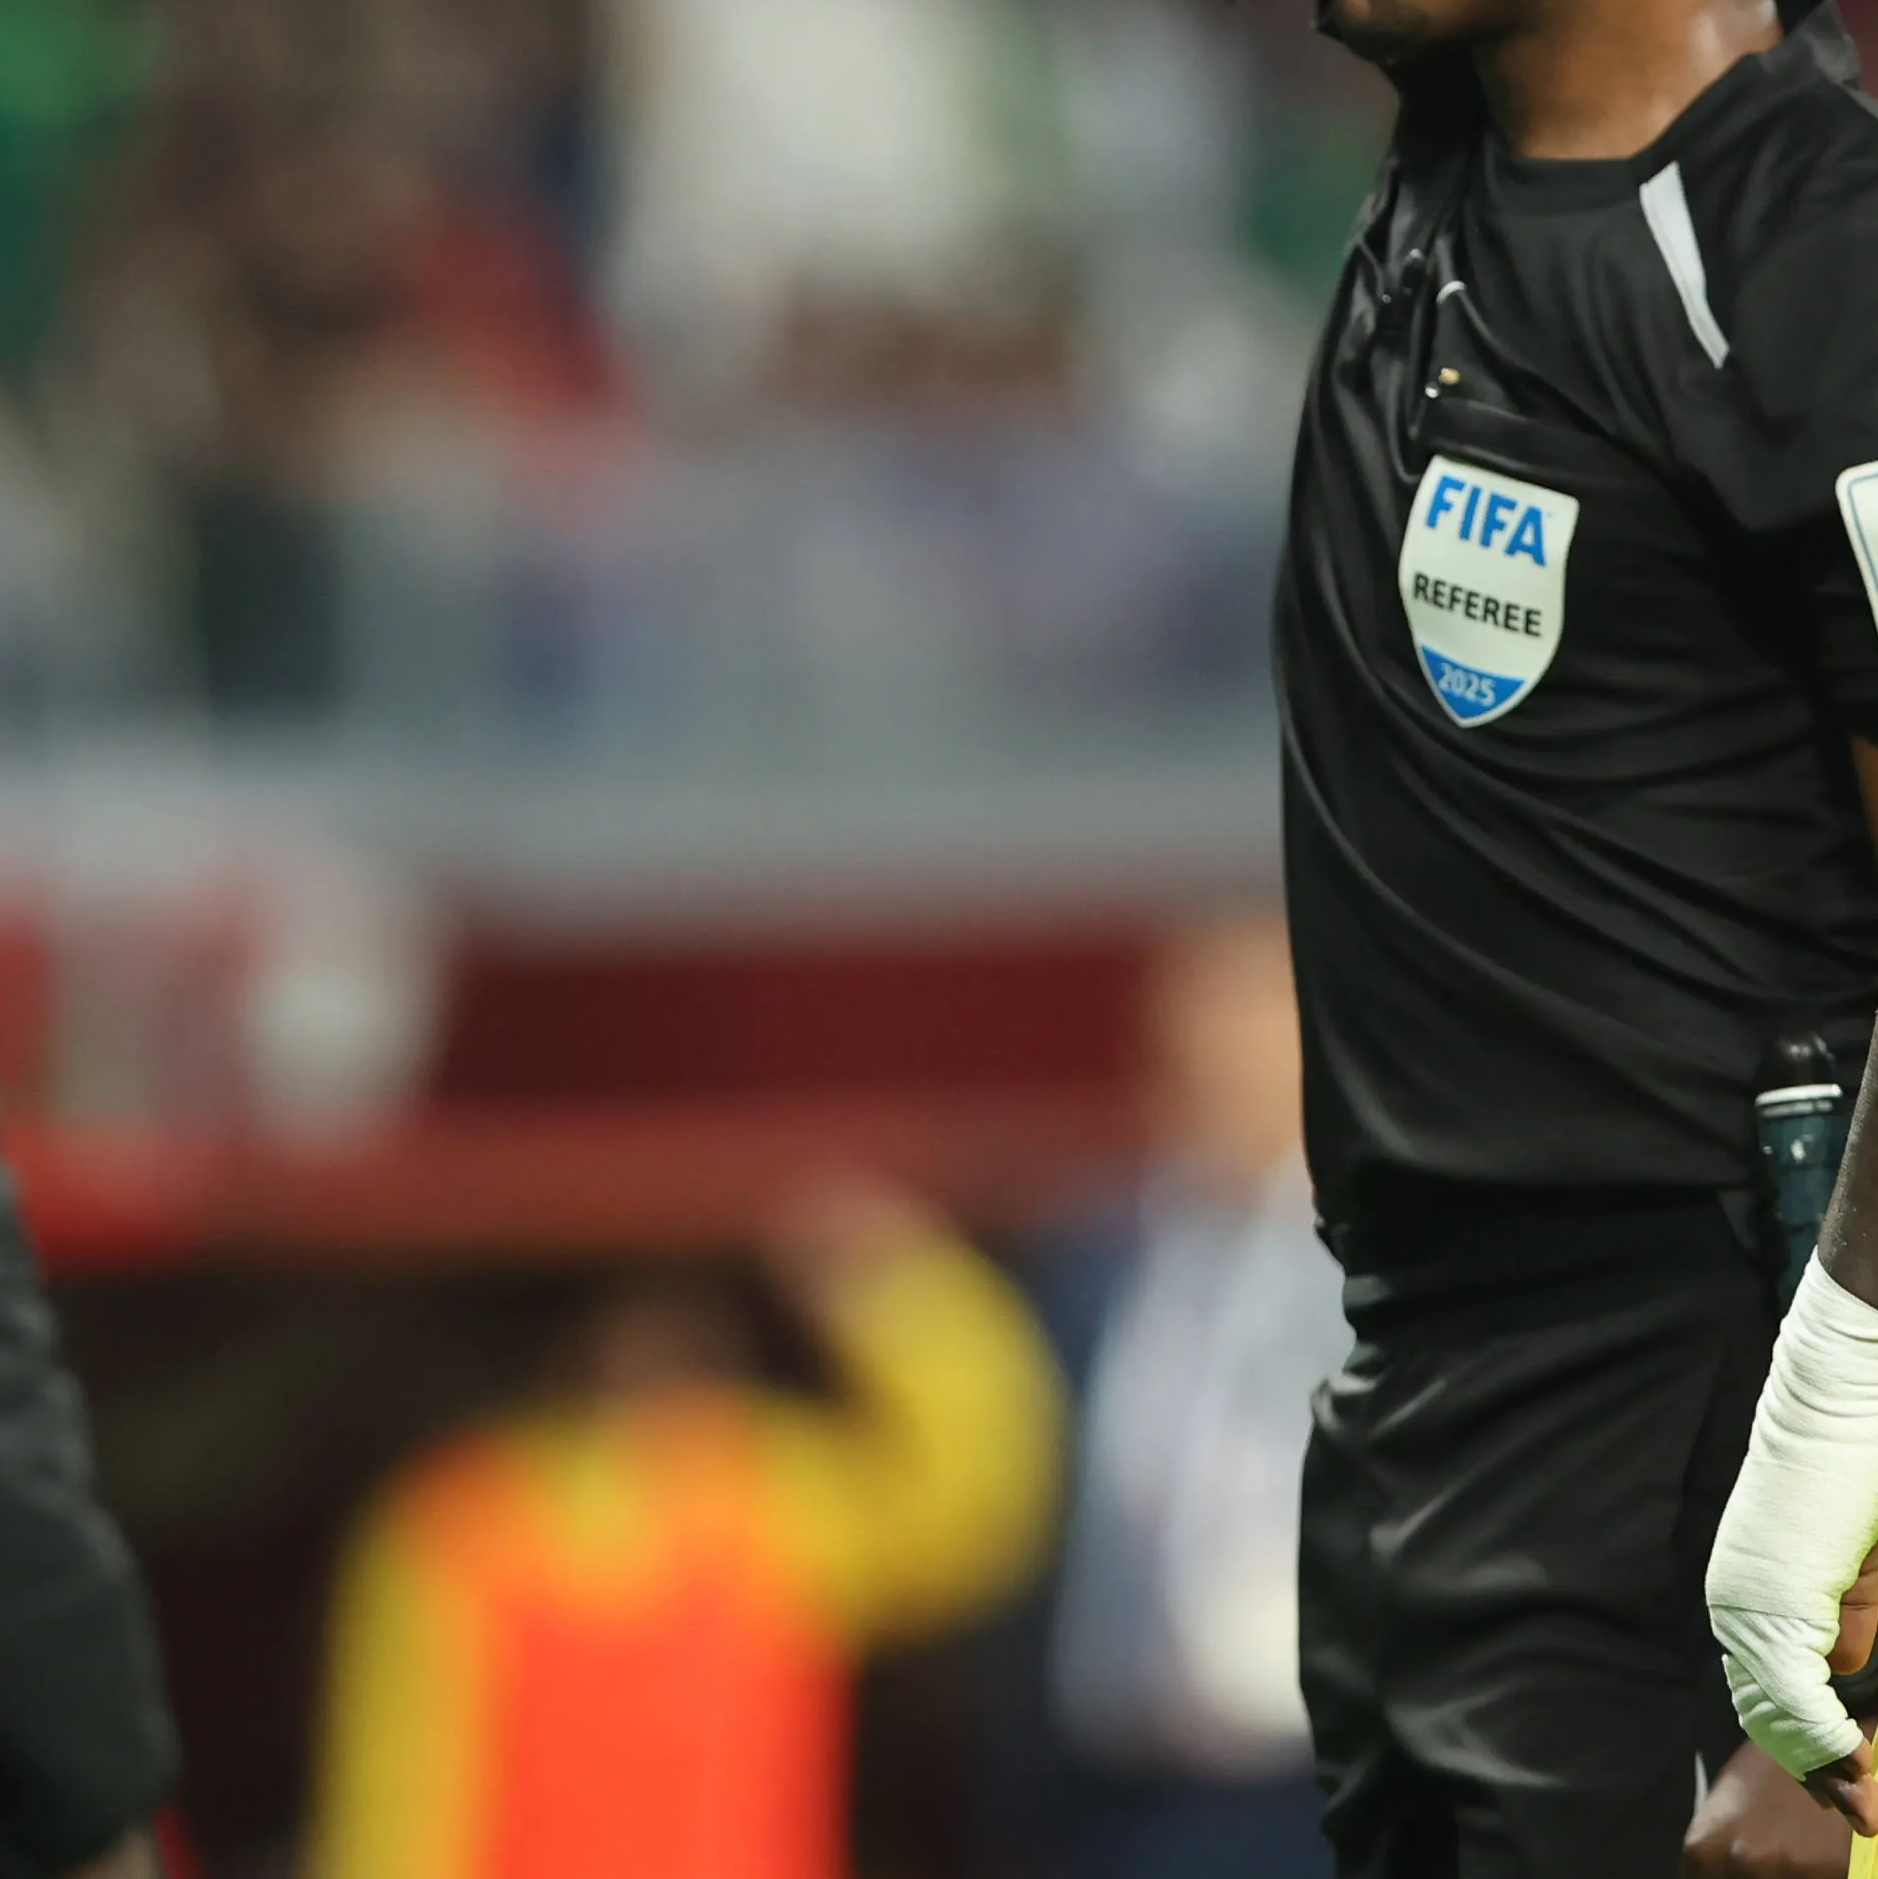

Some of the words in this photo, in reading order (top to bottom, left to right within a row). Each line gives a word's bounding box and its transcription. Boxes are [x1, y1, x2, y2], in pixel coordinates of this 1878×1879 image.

[1424, 474, 1547, 567] FIFA
[1412, 573, 1543, 638] REFEREE
[1438, 662, 1497, 707] 2025
